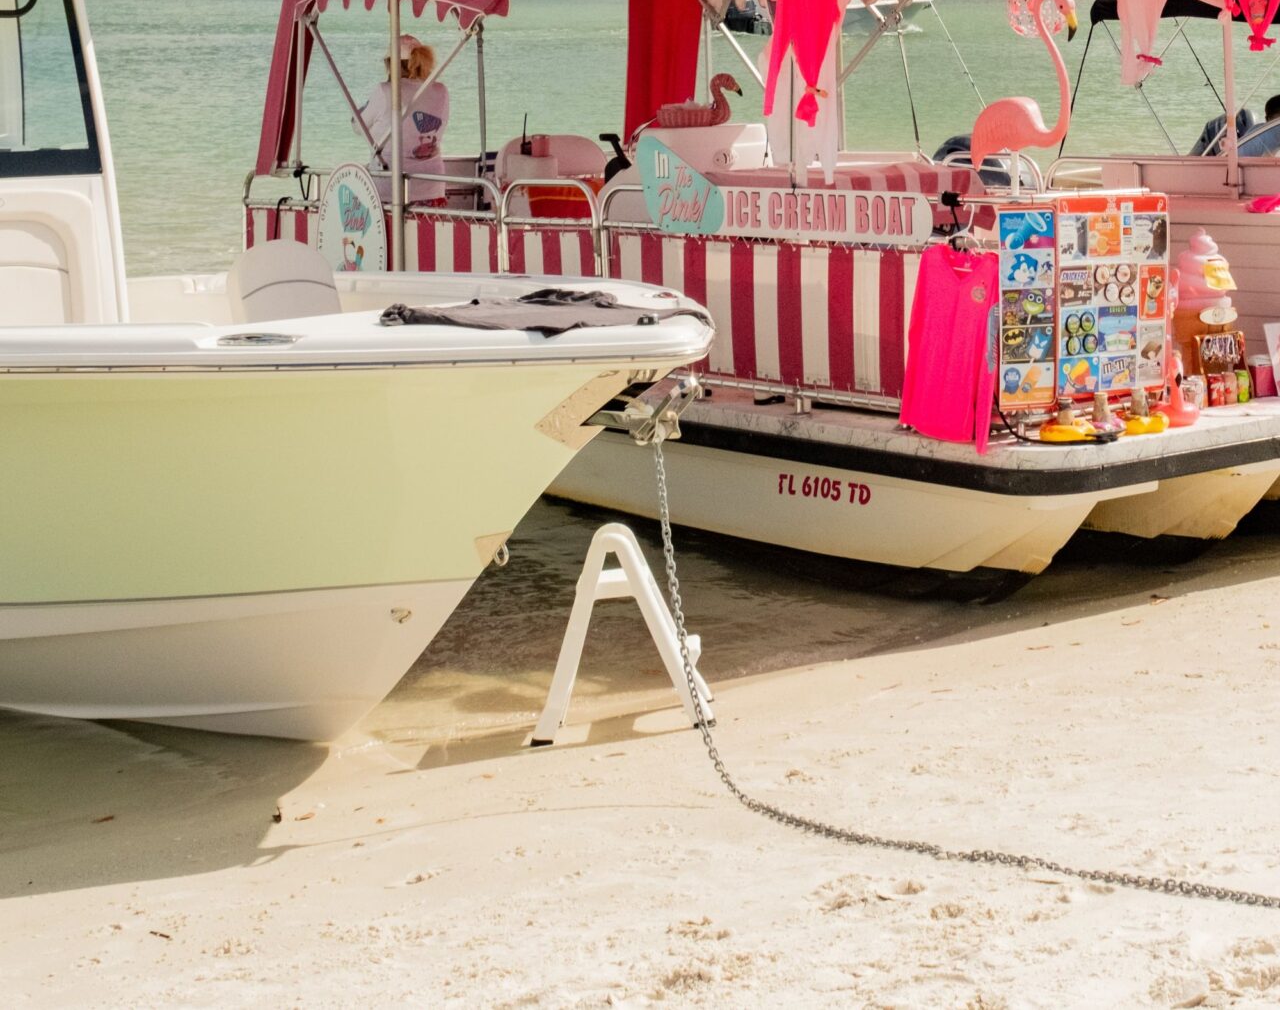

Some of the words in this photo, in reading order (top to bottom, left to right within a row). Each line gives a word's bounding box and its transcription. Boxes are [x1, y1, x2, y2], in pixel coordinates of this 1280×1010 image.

[654, 149, 669, 178] In
[674, 166, 693, 190] The
[658, 183, 711, 228] Pink!
[727, 191, 761, 228] ICE
[768, 192, 846, 232] CREAM
[855, 195, 915, 236] BOAT
[802, 476, 841, 501] 6105
[848, 482, 871, 505] TD
